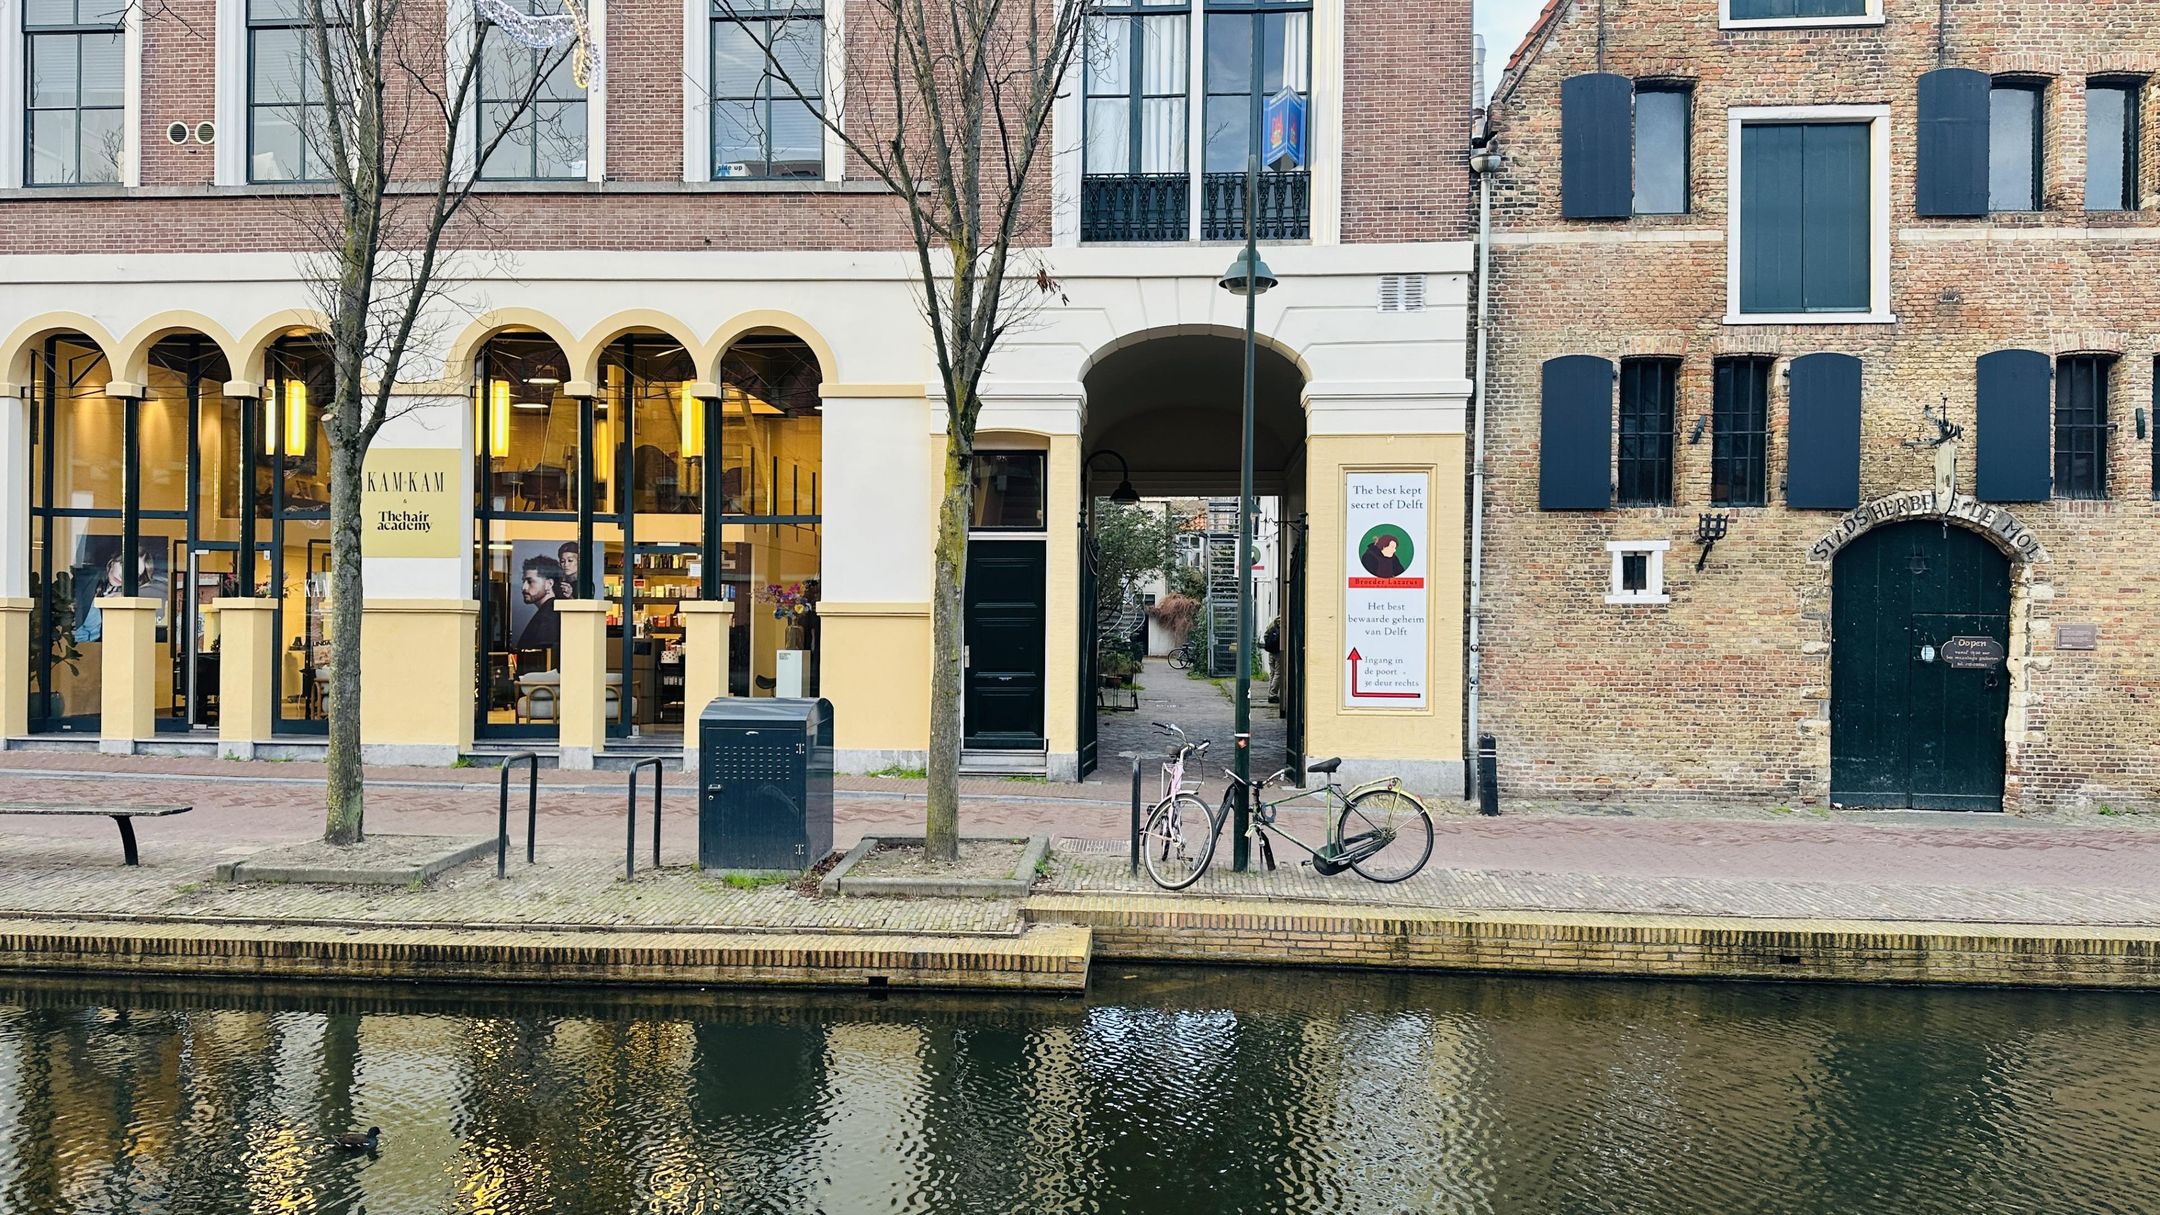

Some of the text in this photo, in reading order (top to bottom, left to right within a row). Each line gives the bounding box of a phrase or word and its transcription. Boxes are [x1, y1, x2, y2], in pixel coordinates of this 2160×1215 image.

[1352, 485, 1422, 497] The best kept
[1351, 499, 1423, 509] secret of Delft
[377, 521, 433, 533] academy
[1972, 502, 1996, 524] DE
[2002, 519, 2040, 560] MOL
[1368, 602, 1405, 611] Het best
[1348, 614, 1425, 625] bewaarde geheim
[1384, 627, 1408, 636] Delft
[1364, 656, 1393, 665] Ingang
[1364, 667, 1397, 677] de poort
[1395, 679, 1420, 687] rechts
